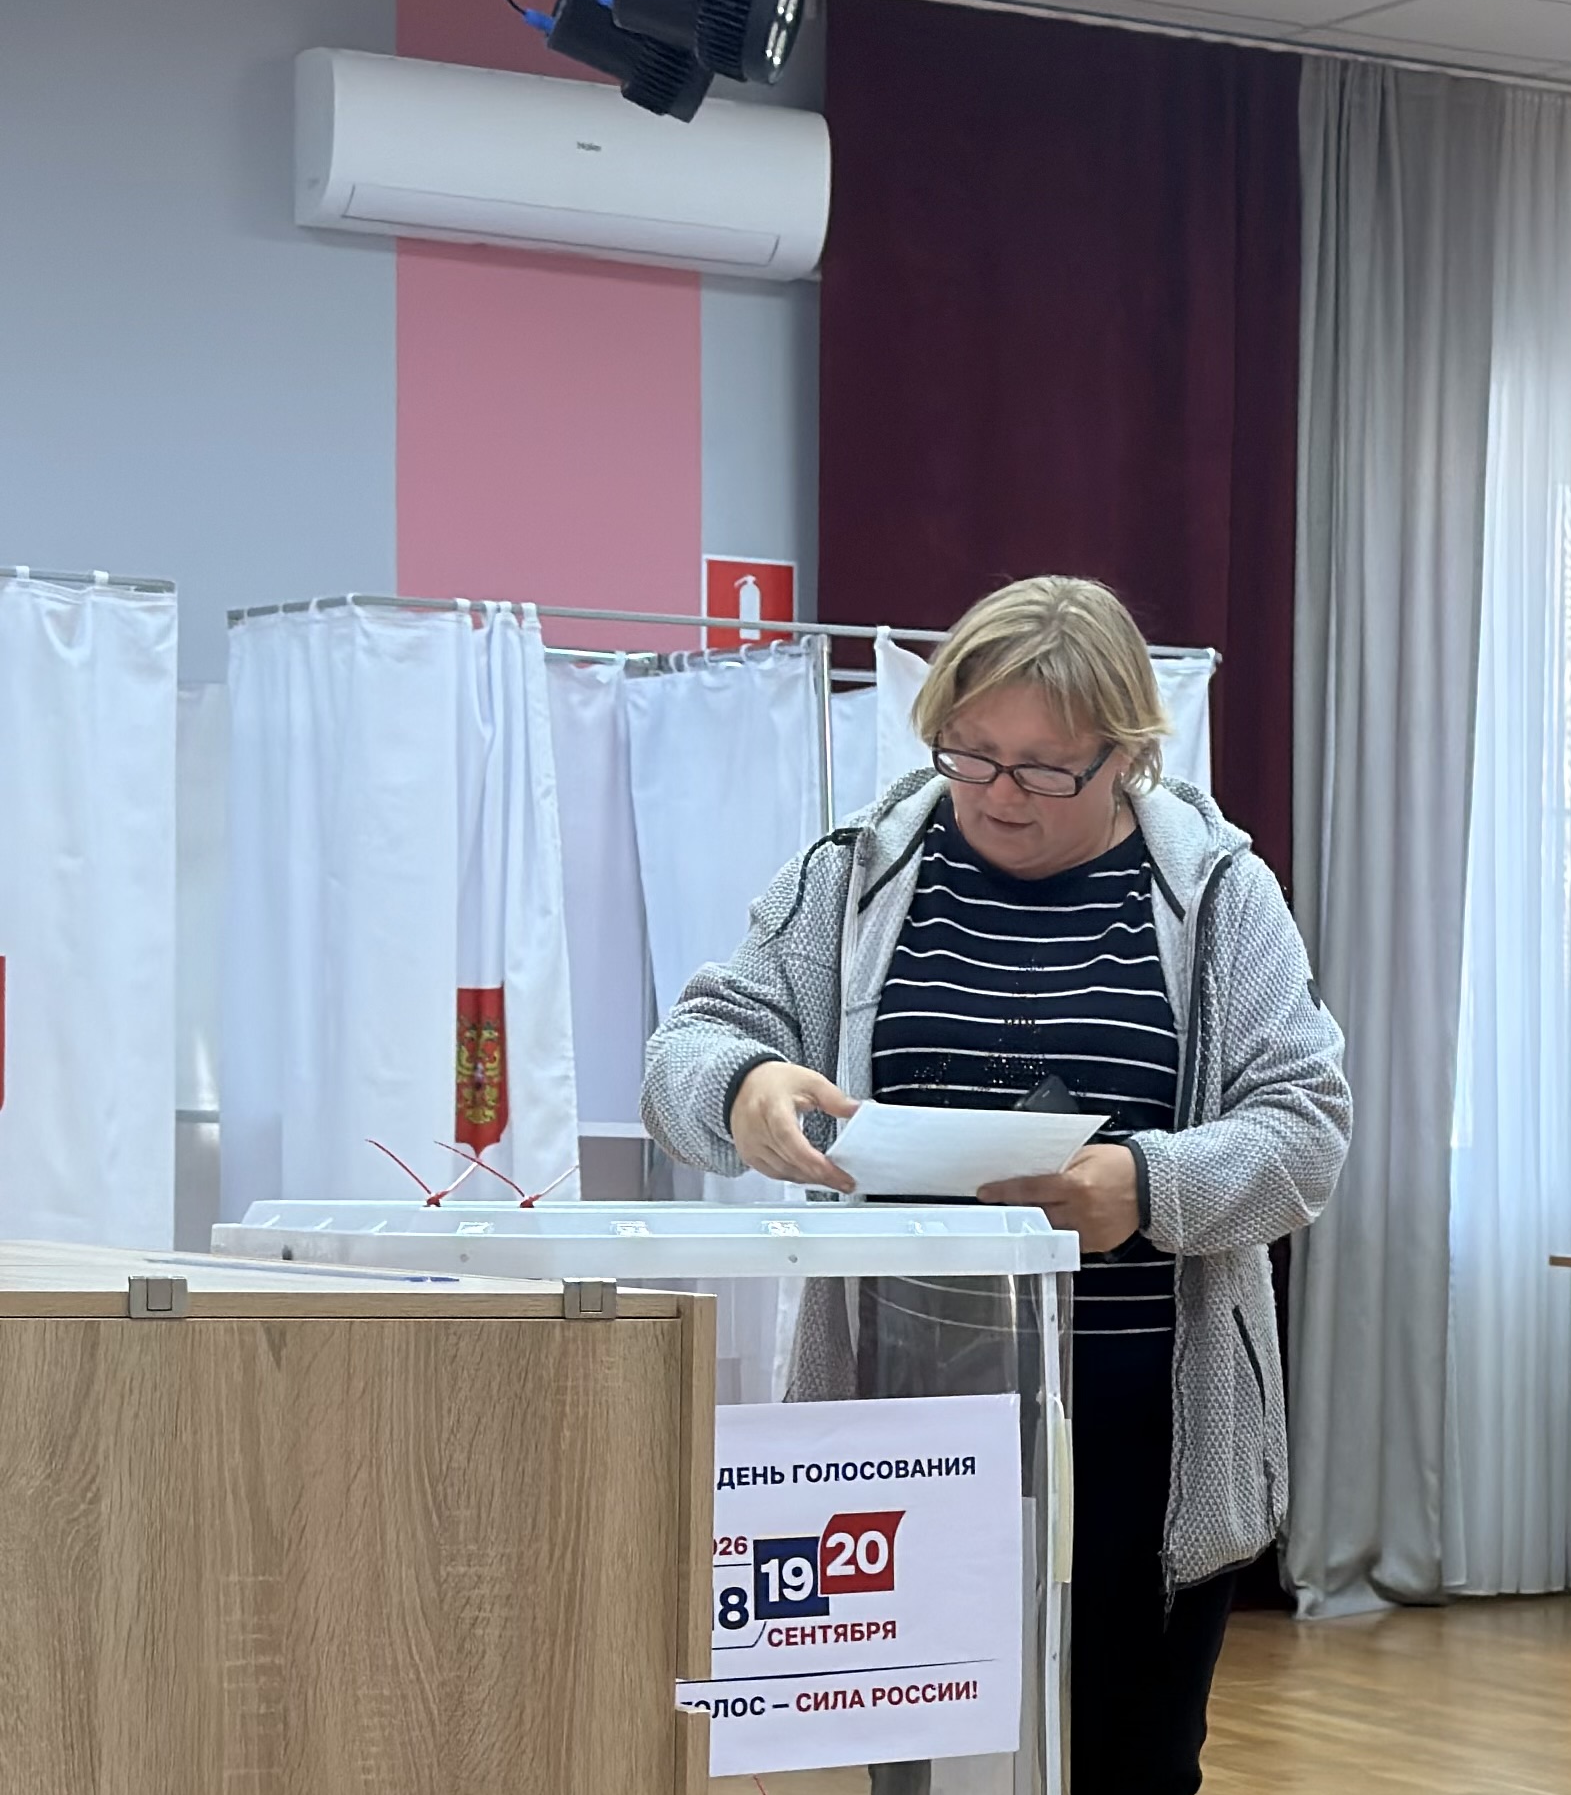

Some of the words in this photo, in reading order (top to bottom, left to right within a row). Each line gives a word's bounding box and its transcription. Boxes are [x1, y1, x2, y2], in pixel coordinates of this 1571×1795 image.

[716, 1464, 785, 1491] ДЕНЬ
[792, 1456, 977, 1484] ГОЛОСОВАНИЯ
[713, 1536, 748, 1556] 26
[711, 1587, 750, 1630] 8
[760, 1557, 814, 1603] 19
[825, 1530, 889, 1577] 20
[767, 1620, 897, 1648] СЕНТЯБРЯ
[680, 1696, 766, 1719] ЛОС
[796, 1687, 865, 1713] СИЛА
[871, 1680, 979, 1707] РОССИИ!
